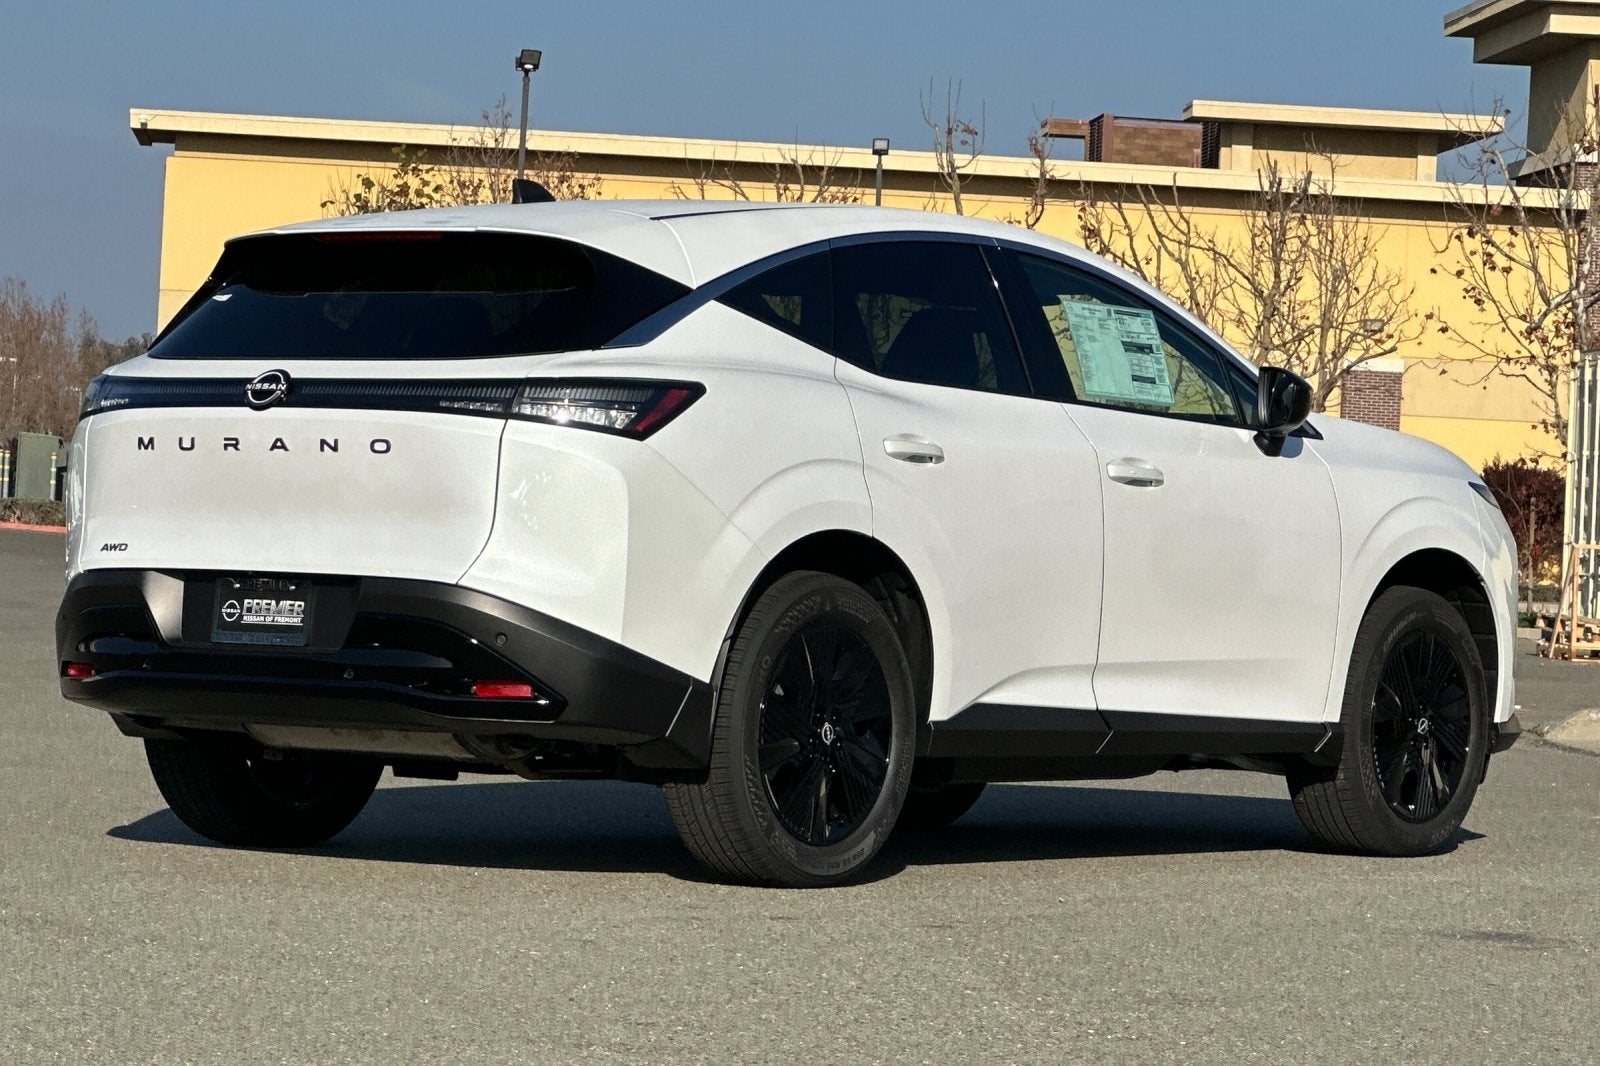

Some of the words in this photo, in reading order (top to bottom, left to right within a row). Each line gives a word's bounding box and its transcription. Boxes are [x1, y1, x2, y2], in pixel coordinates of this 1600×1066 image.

[137, 436, 392, 454] MURANO
[100, 543, 129, 552] AWD
[243, 599, 305, 616] PREMIER
[274, 616, 303, 624] FREMONT
